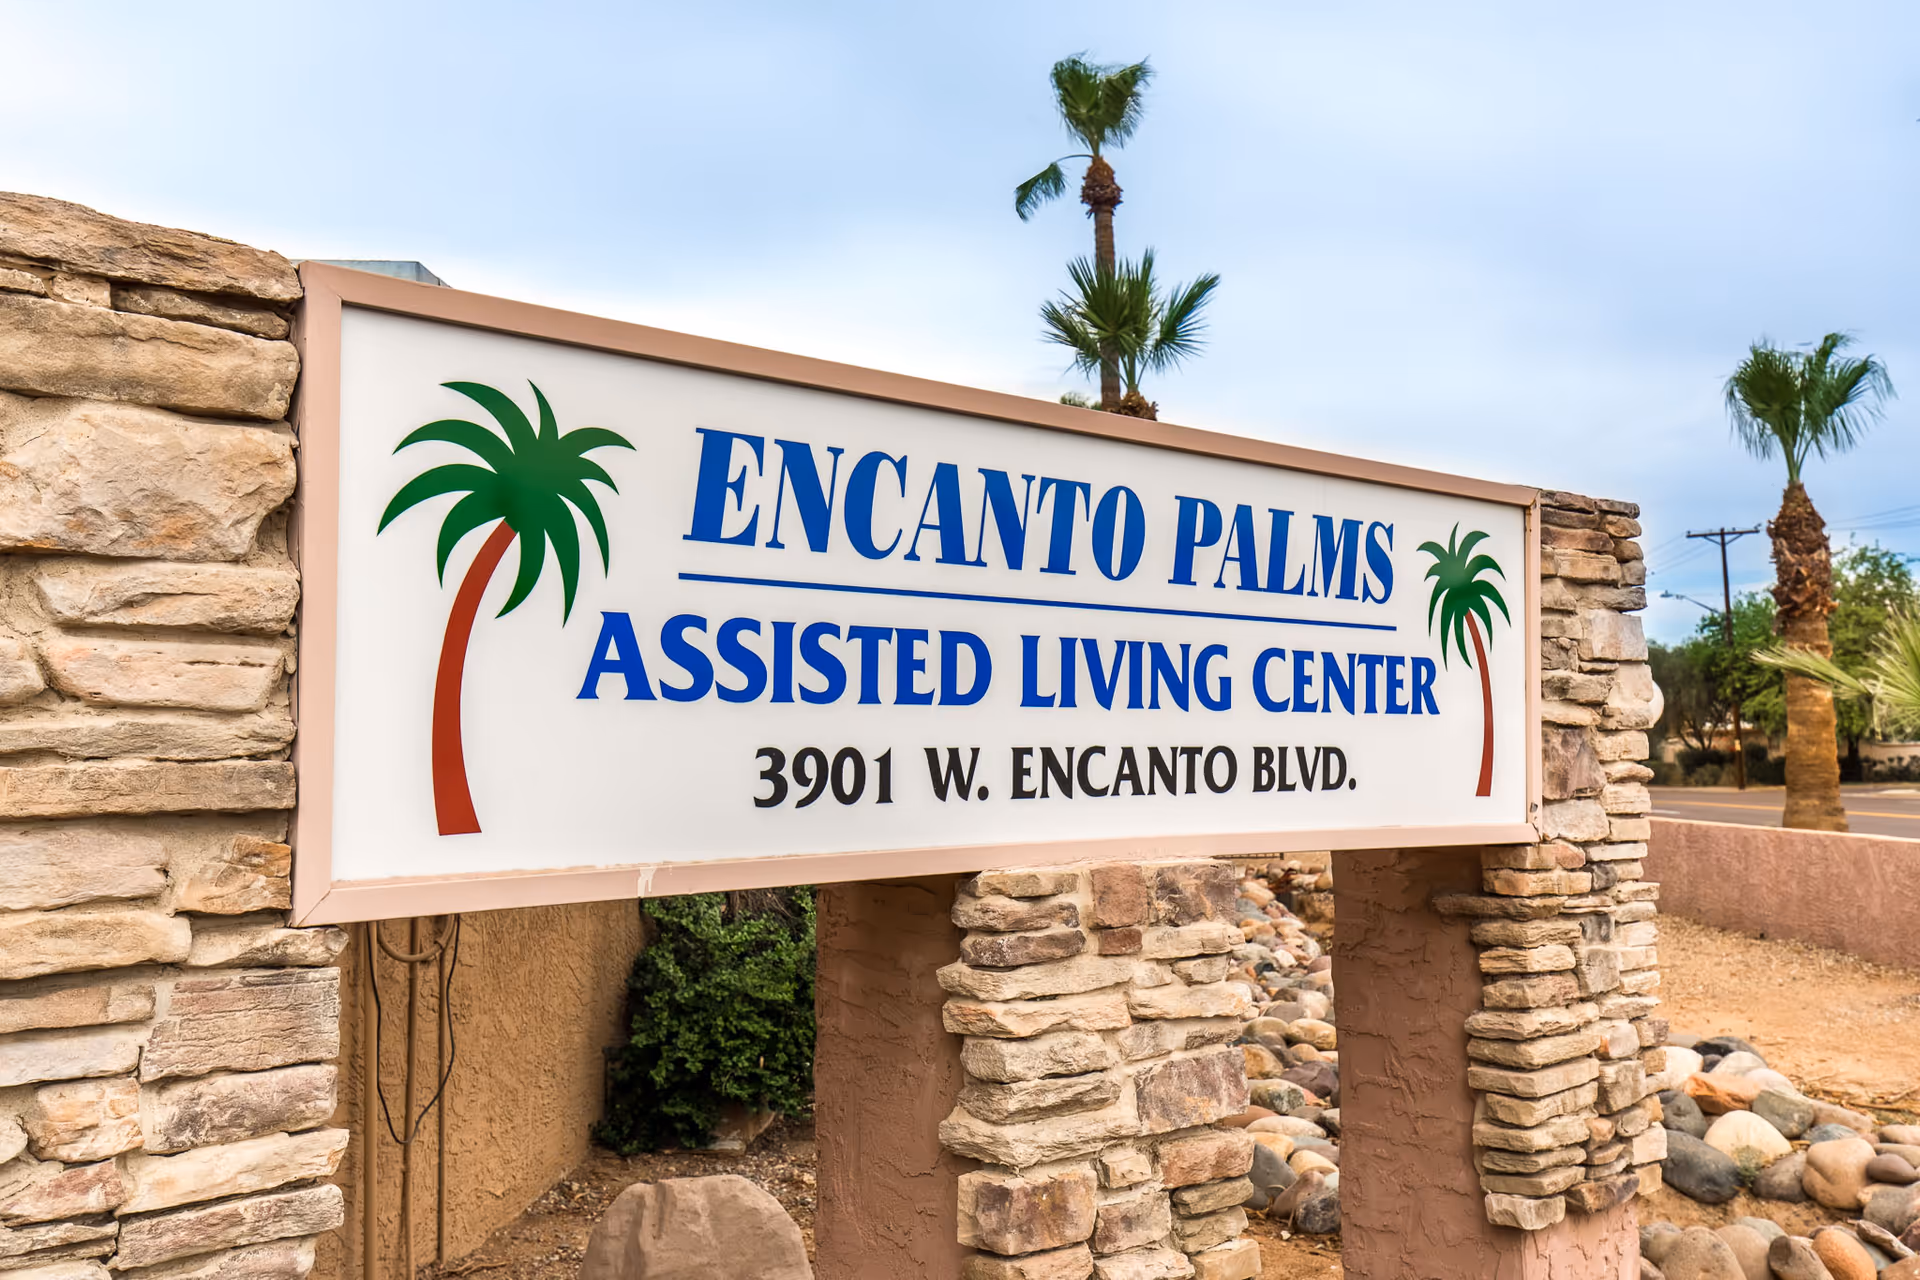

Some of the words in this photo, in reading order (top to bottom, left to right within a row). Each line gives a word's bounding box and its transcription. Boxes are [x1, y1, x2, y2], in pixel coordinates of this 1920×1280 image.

[683, 428, 1145, 581] ENCANTO
[1168, 496, 1393, 604] PALMS
[577, 612, 992, 706] ASSISTED
[1020, 635, 1231, 711] LIVING
[1253, 648, 1440, 715] CENTER
[754, 747, 893, 808] 3901
[924, 747, 989, 802] W.
[1011, 746, 1237, 799] ENCANTO
[1253, 746, 1356, 792] BLVD.
